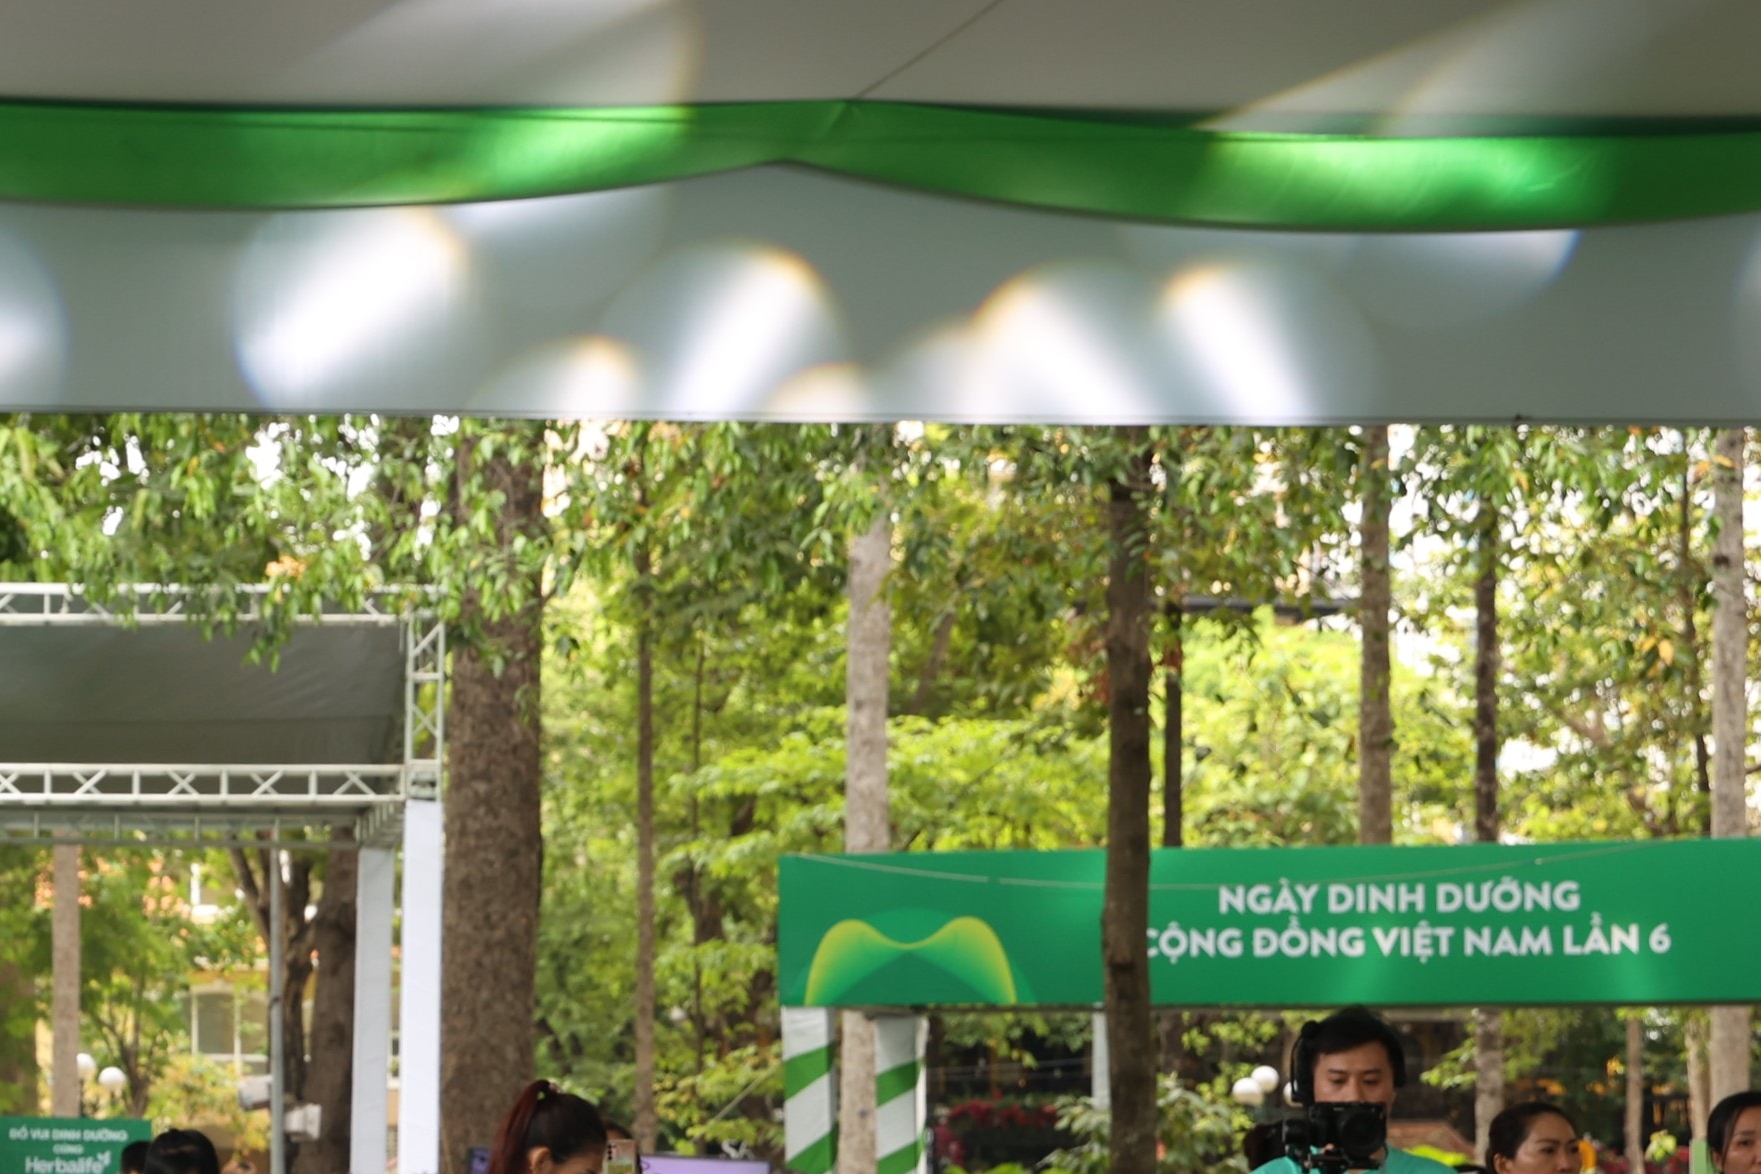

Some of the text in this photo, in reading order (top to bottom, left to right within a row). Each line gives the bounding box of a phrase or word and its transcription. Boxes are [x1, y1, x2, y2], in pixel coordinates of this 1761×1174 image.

[1218, 876, 1581, 914] NGÀY DINH DƯỠNG
[1253, 914, 1365, 958] ĐỒNG
[1372, 920, 1455, 964] VIỆT
[1464, 926, 1554, 957] NAM
[1562, 912, 1639, 956] LẦN
[1649, 923, 1672, 955] 6
